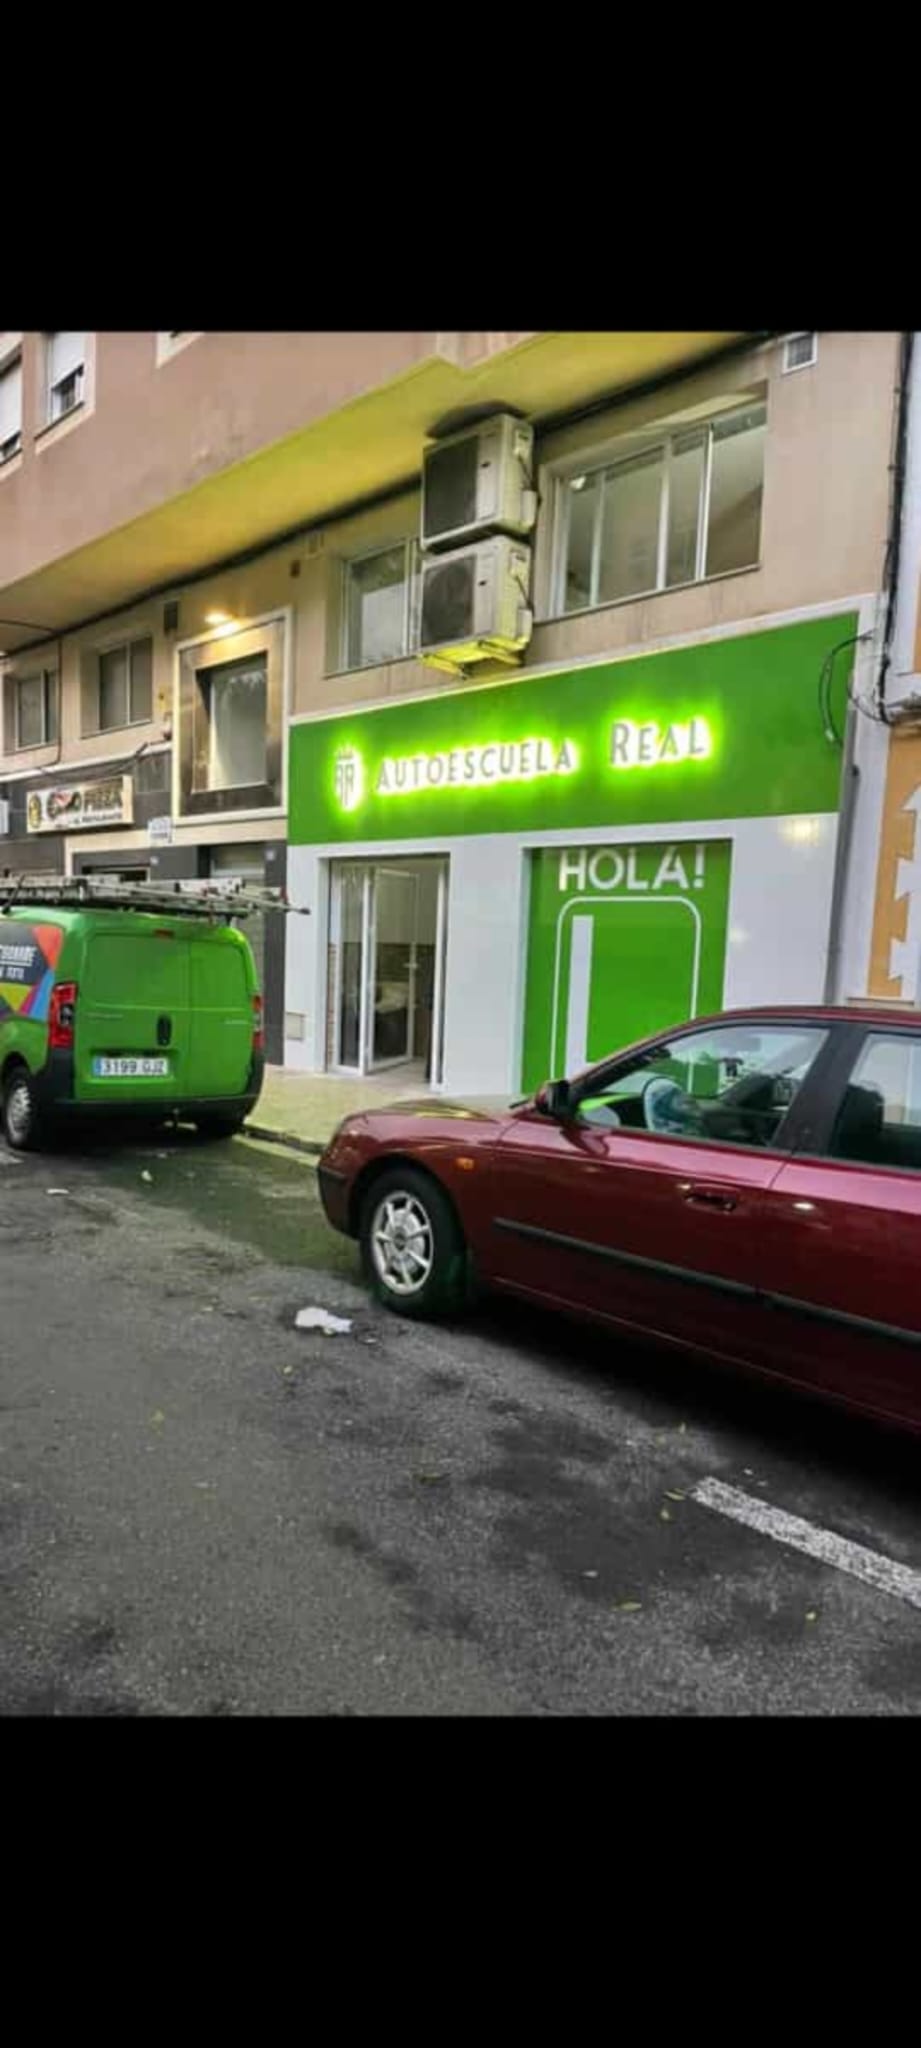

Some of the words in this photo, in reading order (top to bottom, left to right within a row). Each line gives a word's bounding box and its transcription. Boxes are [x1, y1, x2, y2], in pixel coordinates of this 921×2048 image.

[375, 739, 574, 790] AUTOESCUELA
[611, 719, 705, 765] REAL
[558, 846, 706, 891] HOLA!
[104, 1060, 137, 1073] 3199
